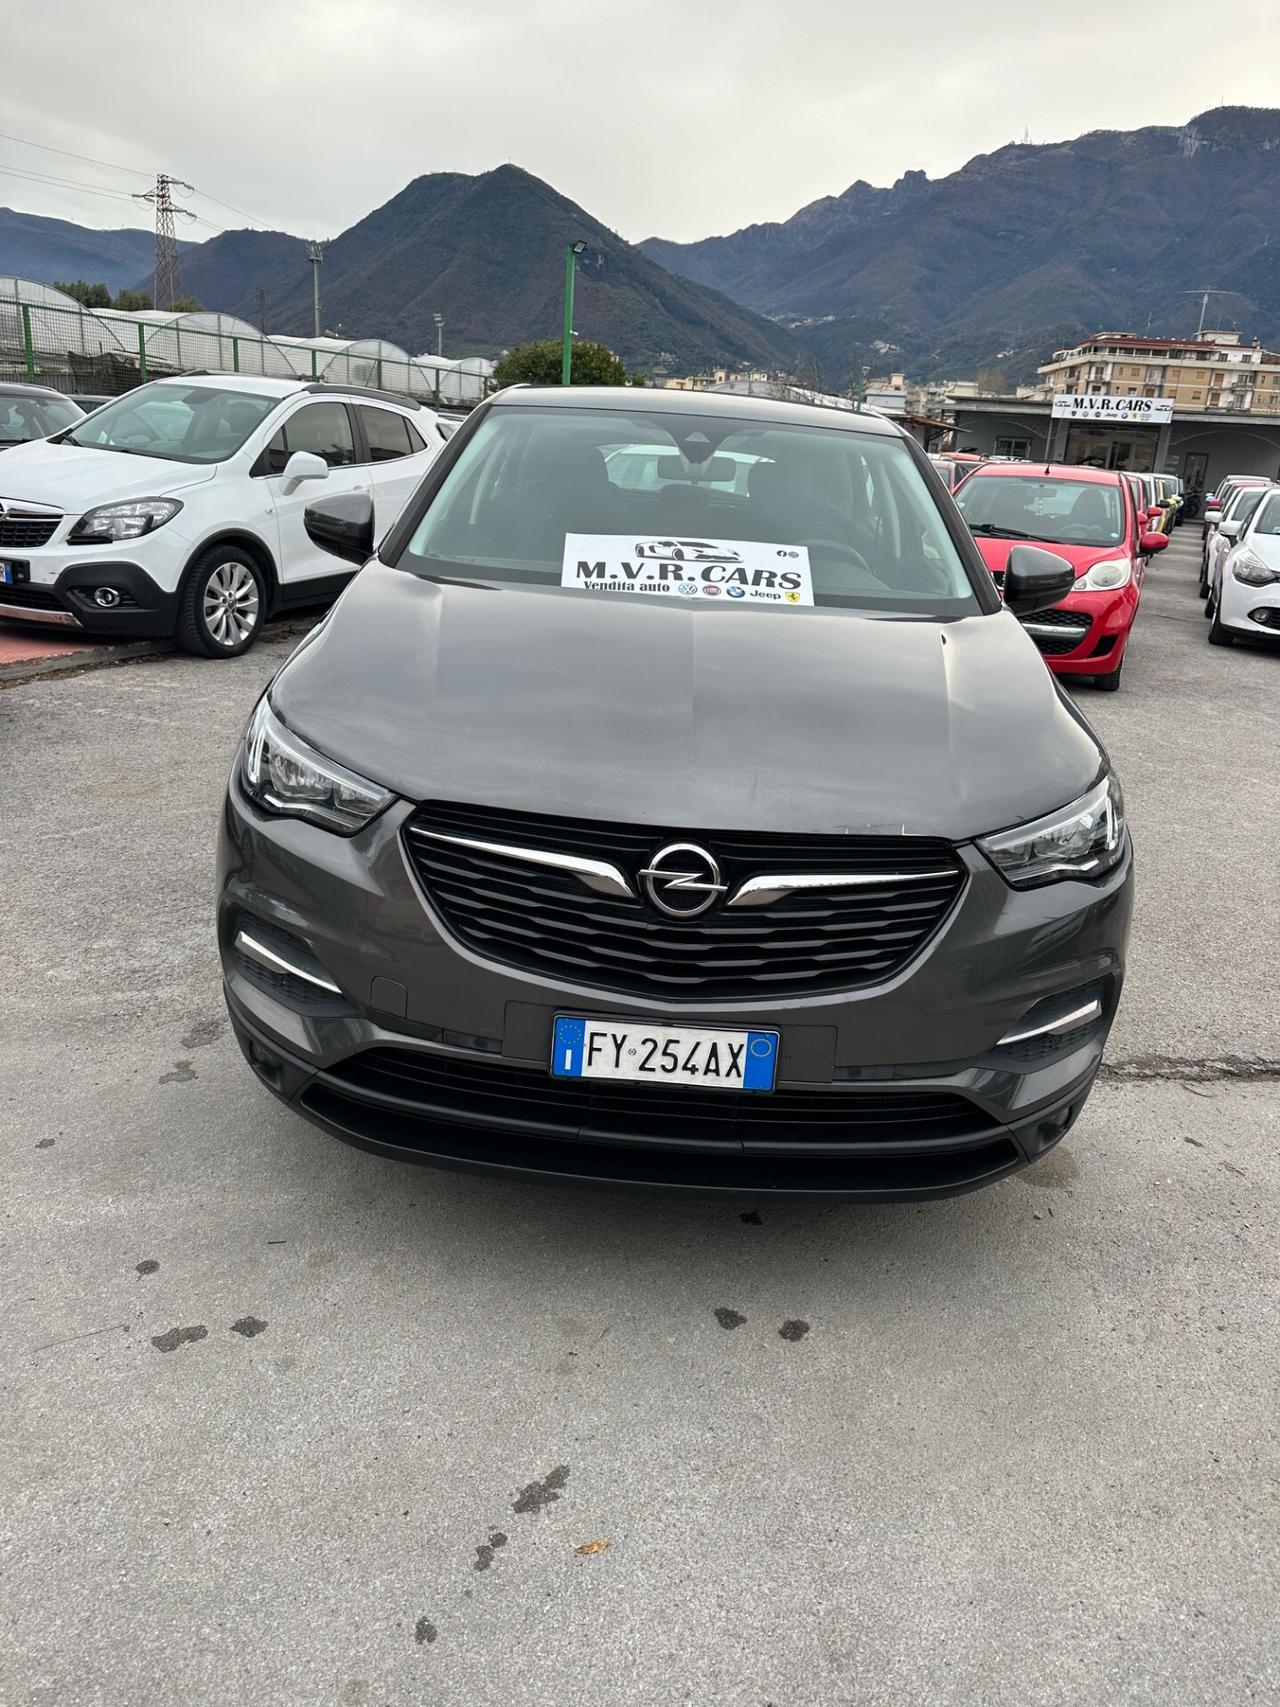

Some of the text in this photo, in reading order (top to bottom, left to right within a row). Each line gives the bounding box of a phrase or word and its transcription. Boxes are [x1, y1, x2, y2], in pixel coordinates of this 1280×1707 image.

[583, 580, 671, 593] Vendita auto
[750, 589, 782, 600] Jeep
[564, 1049, 573, 1070] I
[587, 1032, 745, 1078] FY 254AX
